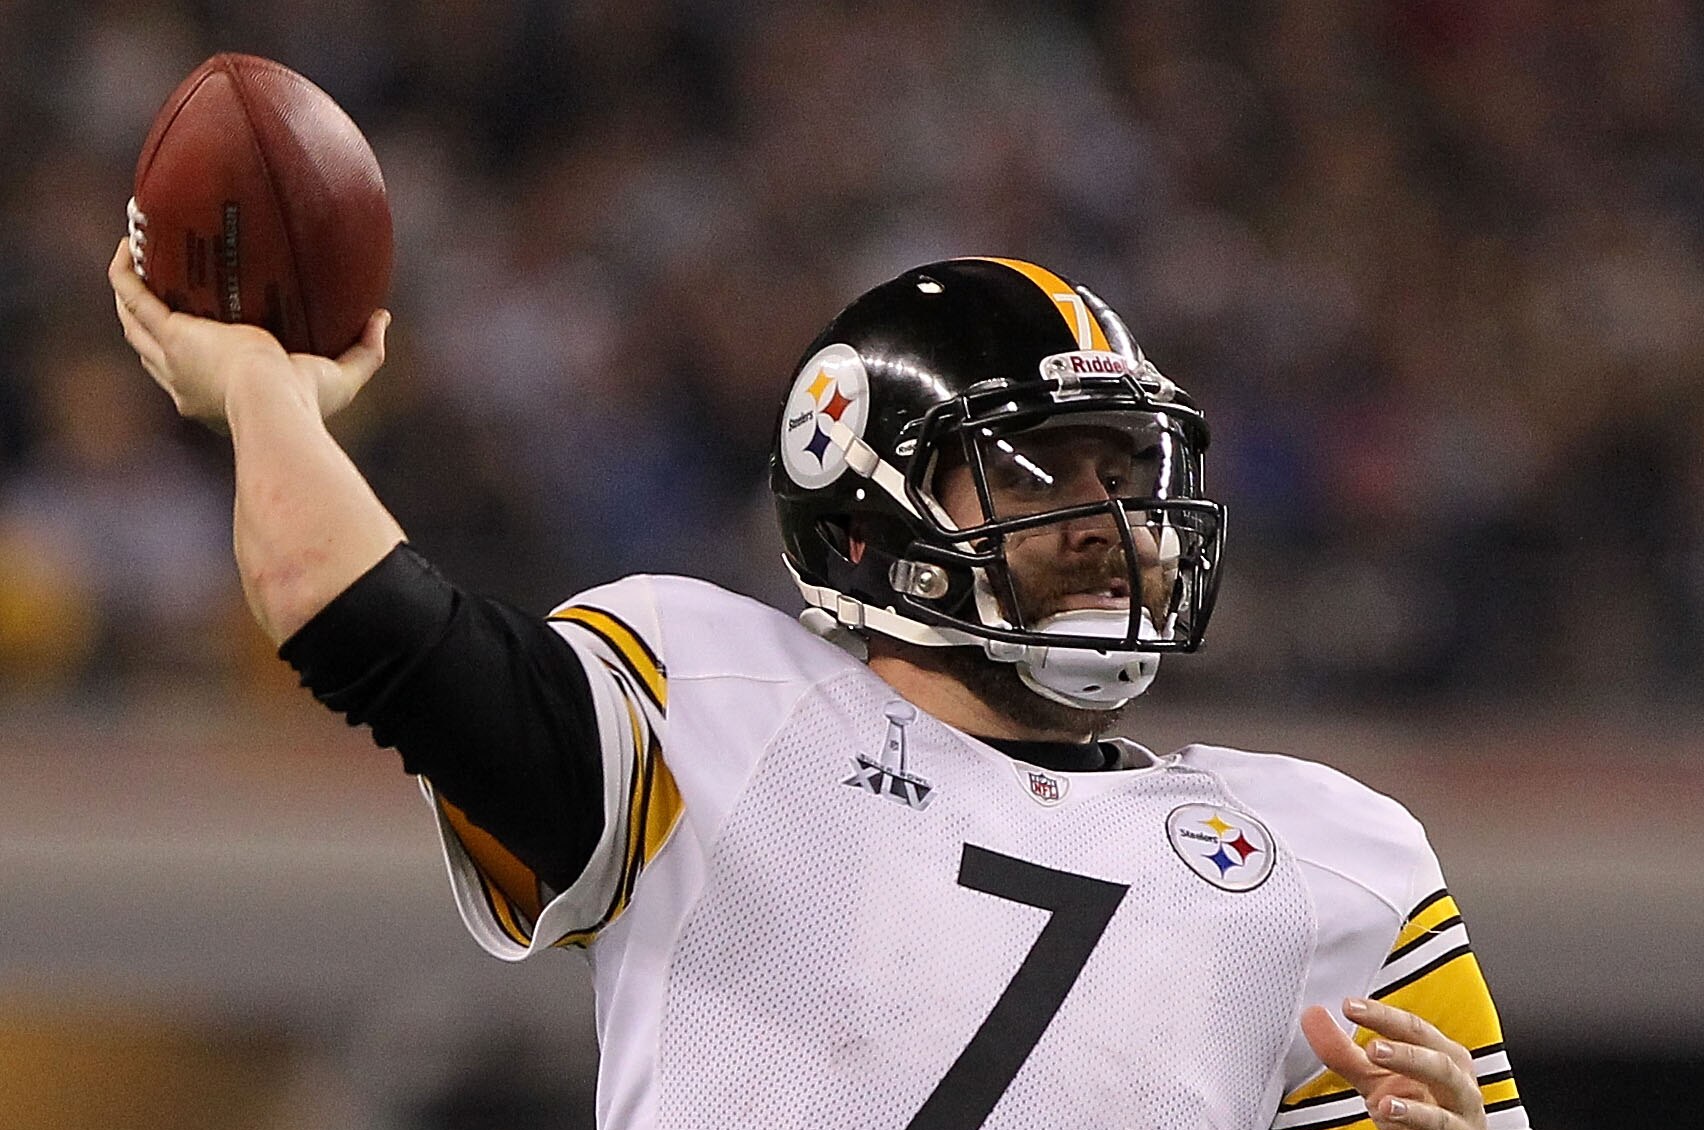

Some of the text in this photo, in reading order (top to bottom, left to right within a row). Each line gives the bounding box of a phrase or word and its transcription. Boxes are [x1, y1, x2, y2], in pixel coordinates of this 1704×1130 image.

[1052, 293, 1093, 351] 7
[842, 757, 938, 812] XLV
[1179, 828, 1219, 844] Steelers
